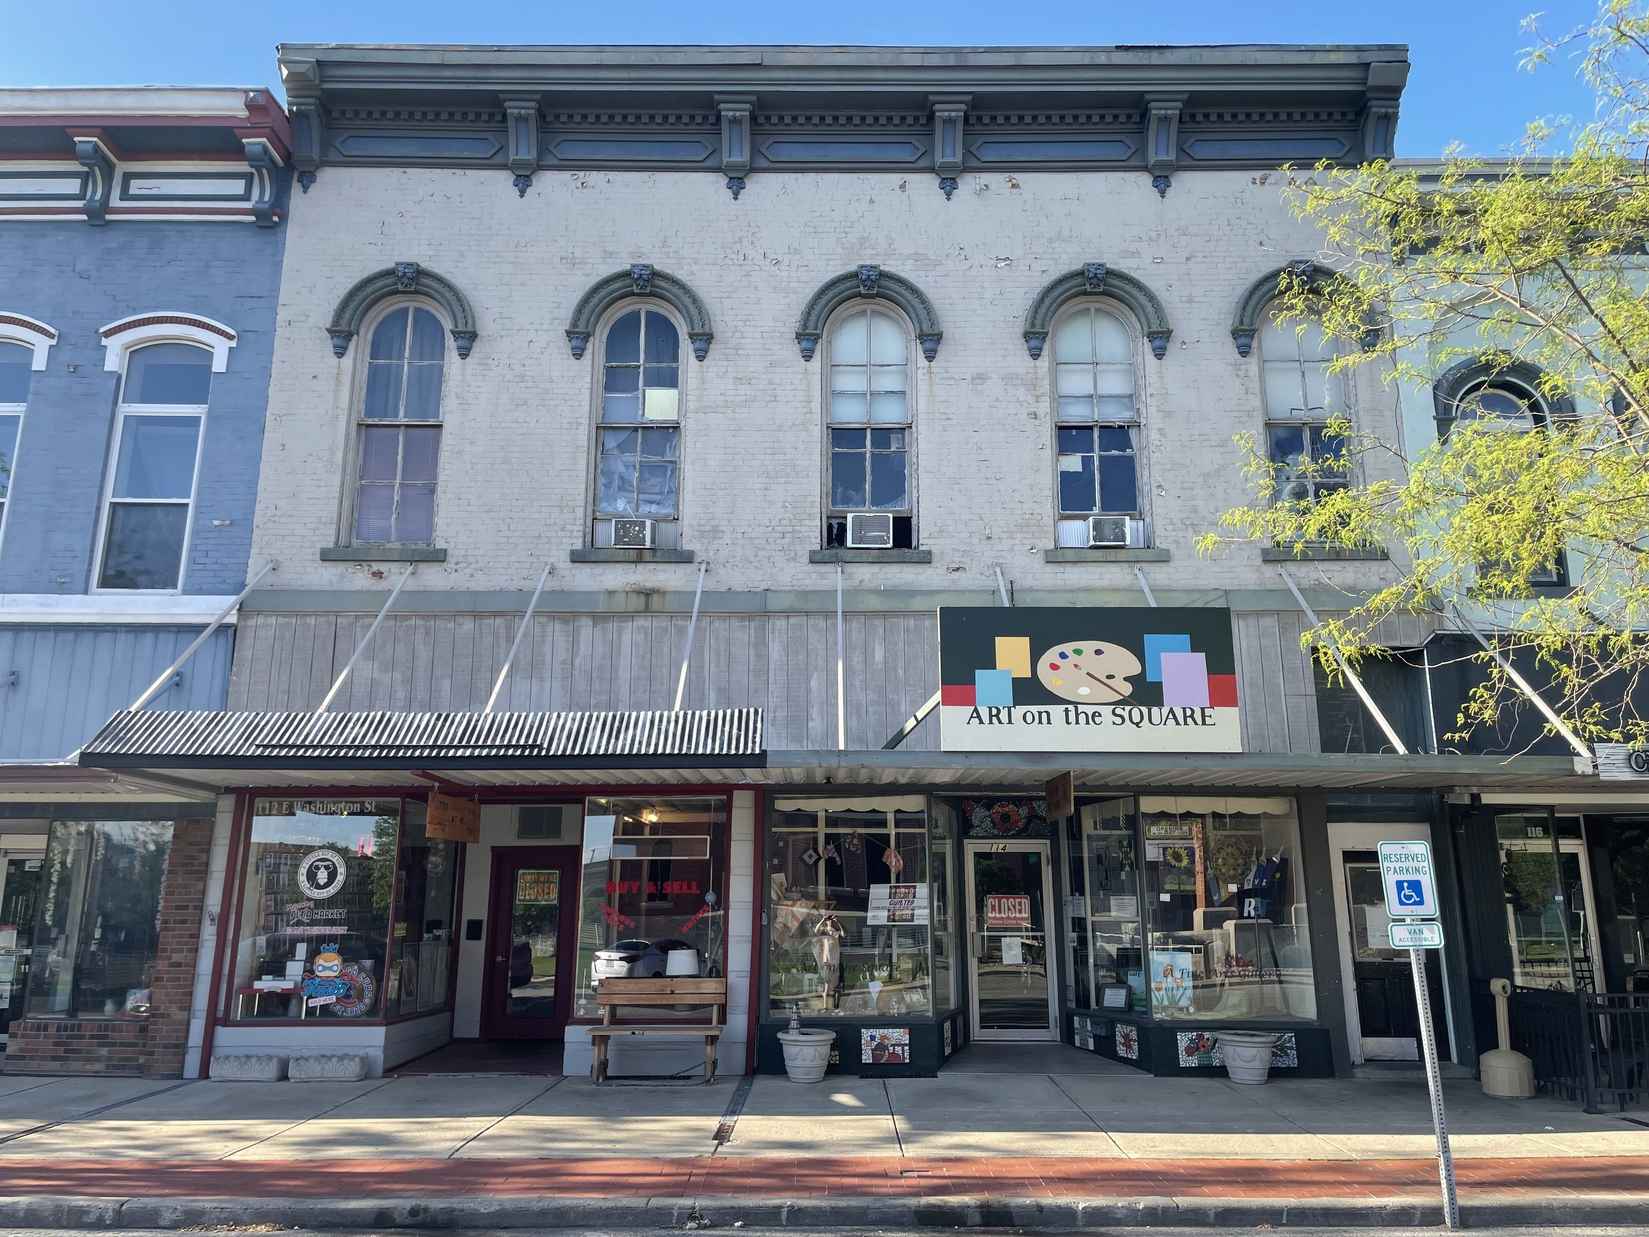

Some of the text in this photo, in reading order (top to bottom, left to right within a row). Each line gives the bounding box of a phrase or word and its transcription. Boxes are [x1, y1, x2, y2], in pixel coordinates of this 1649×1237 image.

[967, 705, 1216, 728] ART on the SQUARE
[1630, 751, 1649, 772] C
[257, 800, 377, 816] 112 E Washington St
[1526, 826, 1544, 838] 116
[990, 842, 1008, 852] 114
[1383, 853, 1427, 863] RESERVED
[1386, 865, 1428, 876] PARKING
[662, 880, 700, 893] SELL
[987, 897, 1030, 918] CLOSED
[313, 909, 347, 920] MARKET
[1407, 927, 1424, 936] VAN
